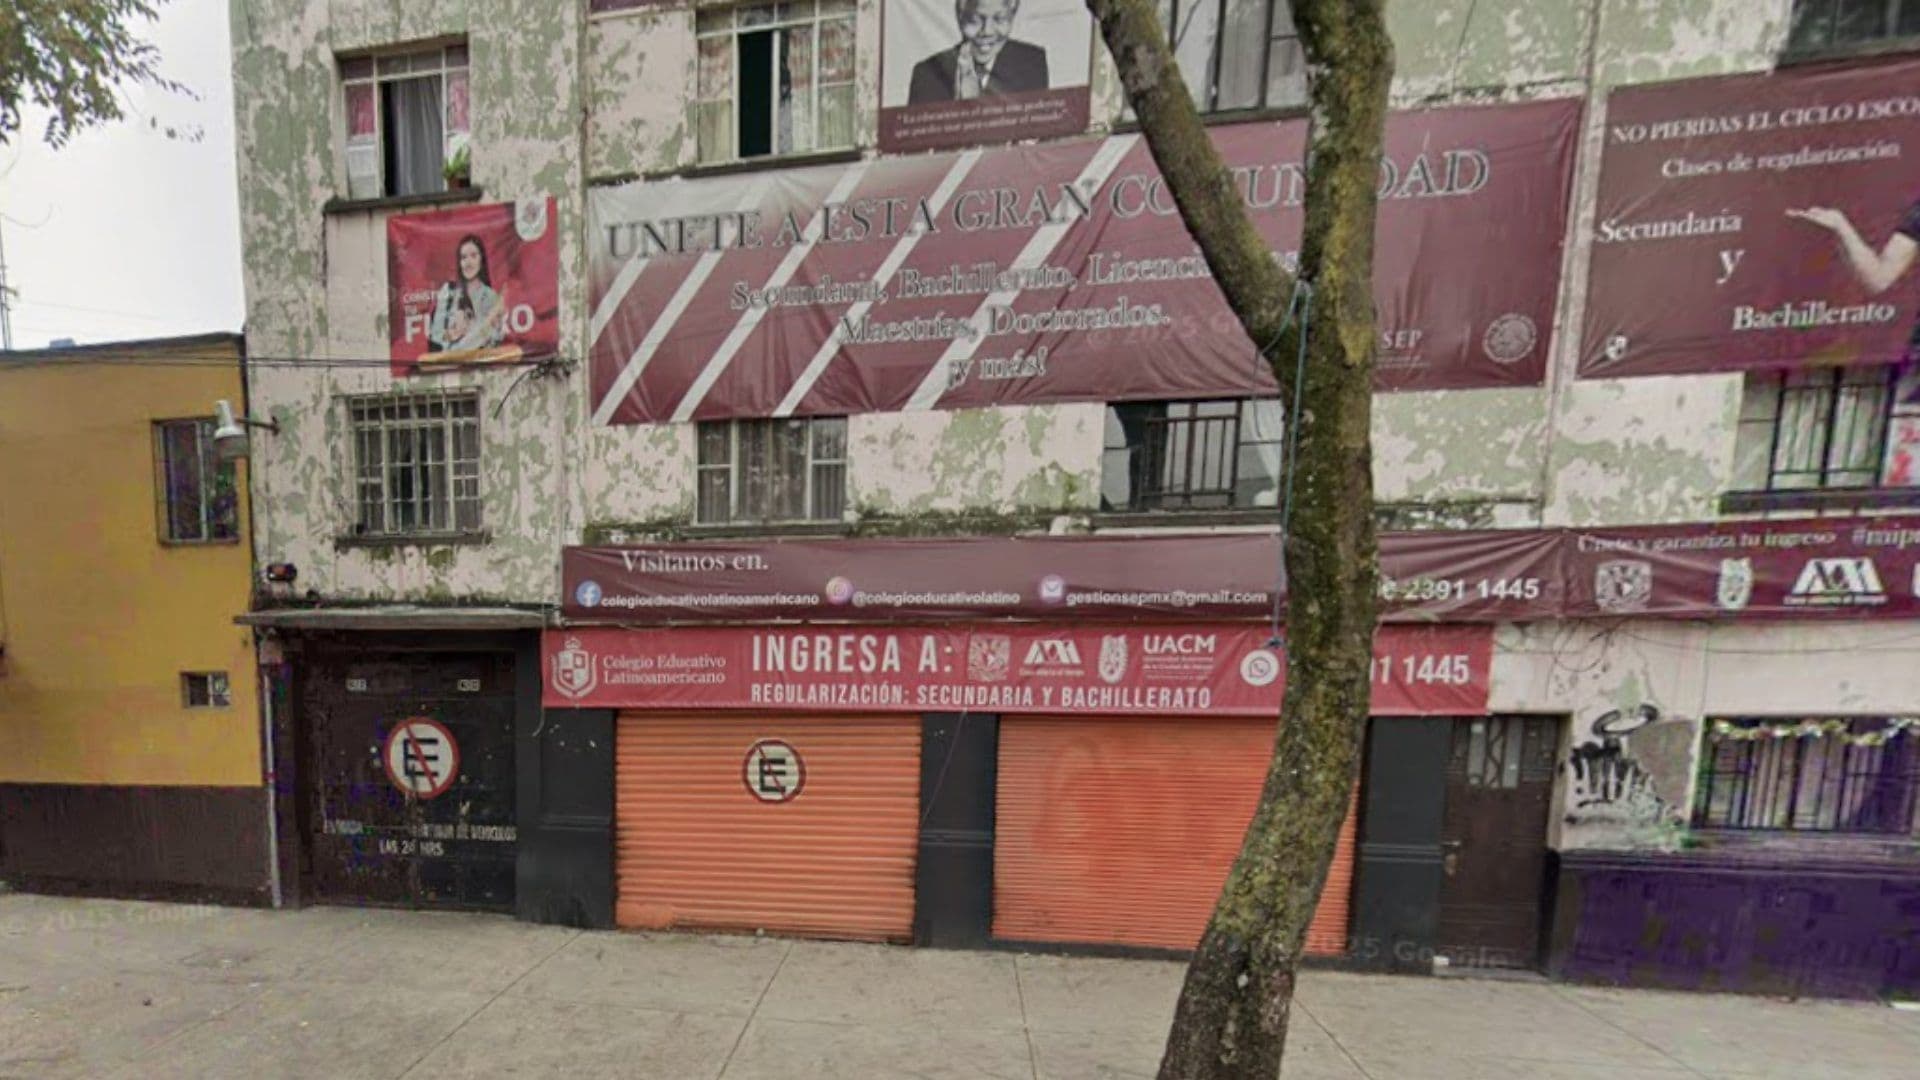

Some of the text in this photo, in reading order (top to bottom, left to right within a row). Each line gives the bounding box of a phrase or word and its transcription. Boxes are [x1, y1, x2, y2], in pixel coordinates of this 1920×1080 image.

[1609, 123, 1647, 144] NO
[1650, 114, 1742, 141] PIERDAS
[1747, 109, 1777, 132] EL
[1780, 104, 1852, 127] CICLO
[1661, 139, 1901, 178] Clases de regularización
[605, 210, 764, 262] UNETE
[773, 212, 810, 248] A
[819, 196, 940, 247] ESTA
[952, 180, 1094, 233] GRAN
[1597, 206, 1743, 243] Secundaria
[896, 261, 1079, 299] Bachillerato,
[1715, 248, 1745, 285] y
[836, 311, 979, 345] Maestrías,
[987, 295, 1171, 337] Doctorados.
[1731, 300, 1897, 331] Bachillerato
[1382, 329, 1423, 349] SEP
[1740, 531, 1760, 547] tu
[1764, 527, 1837, 549] ingreso
[732, 552, 769, 572] en.
[853, 591, 1021, 608] @colegioeducativolatino
[1066, 590, 1268, 607] gestionsepmx@gmail.com
[1404, 578, 1468, 600] 2391
[1476, 577, 1541, 600] 1445
[752, 634, 953, 674] INGRESA A:
[1142, 633, 1217, 654] UACM
[603, 653, 727, 671] Colegio Educativo
[1402, 655, 1470, 685] 1445
[603, 669, 726, 685] Latinoamericano
[751, 680, 1212, 709] REGULARIZACIÓN: SECUNDARIA Y BACHILLERATO
